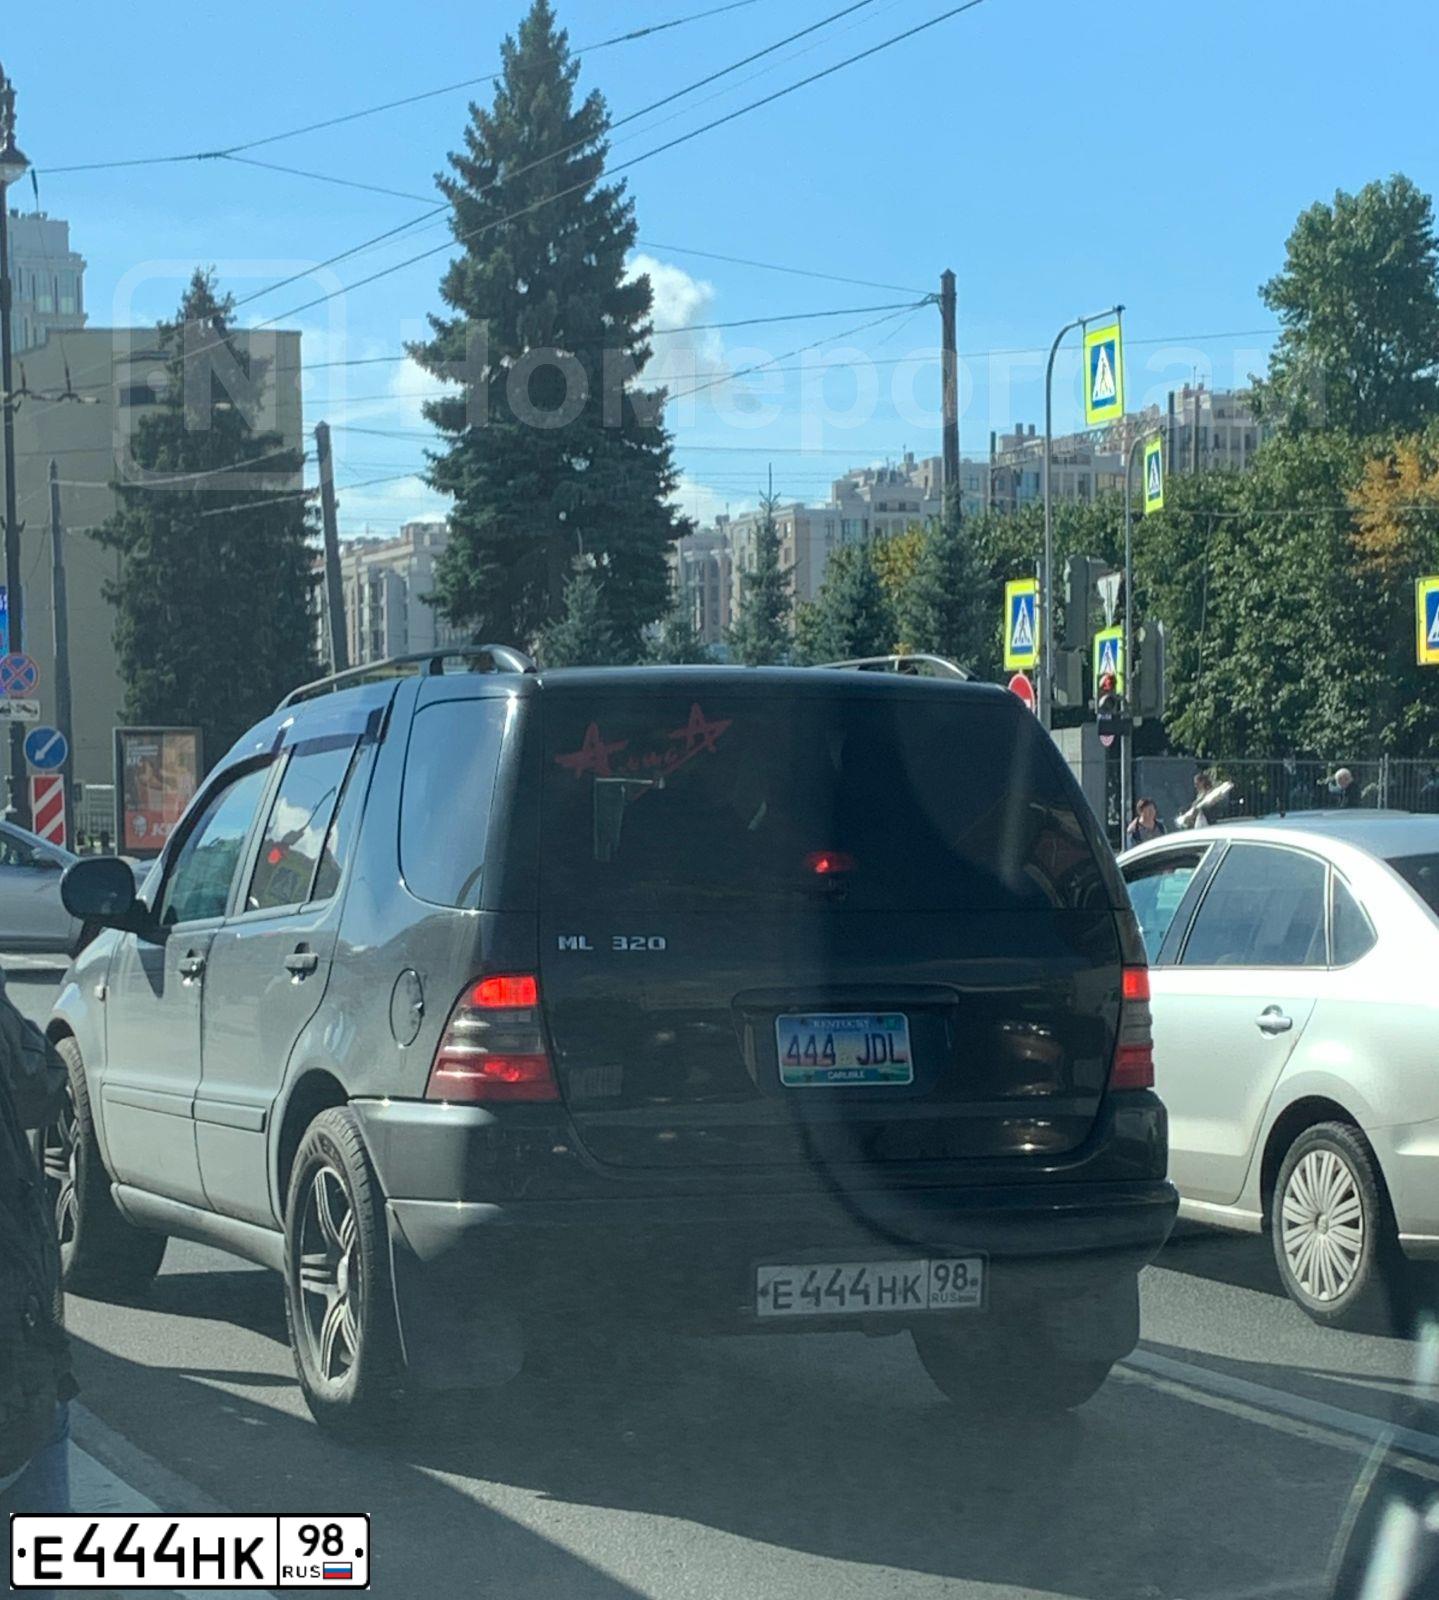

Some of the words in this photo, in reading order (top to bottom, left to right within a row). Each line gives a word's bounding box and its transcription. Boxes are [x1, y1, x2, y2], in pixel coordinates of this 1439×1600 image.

[558, 936, 594, 950] ML
[612, 936, 667, 950] 320
[787, 1033, 836, 1066] 444
[856, 1033, 908, 1066] JDL
[934, 1262, 968, 1292] 98
[932, 1292, 957, 1304] RUS
